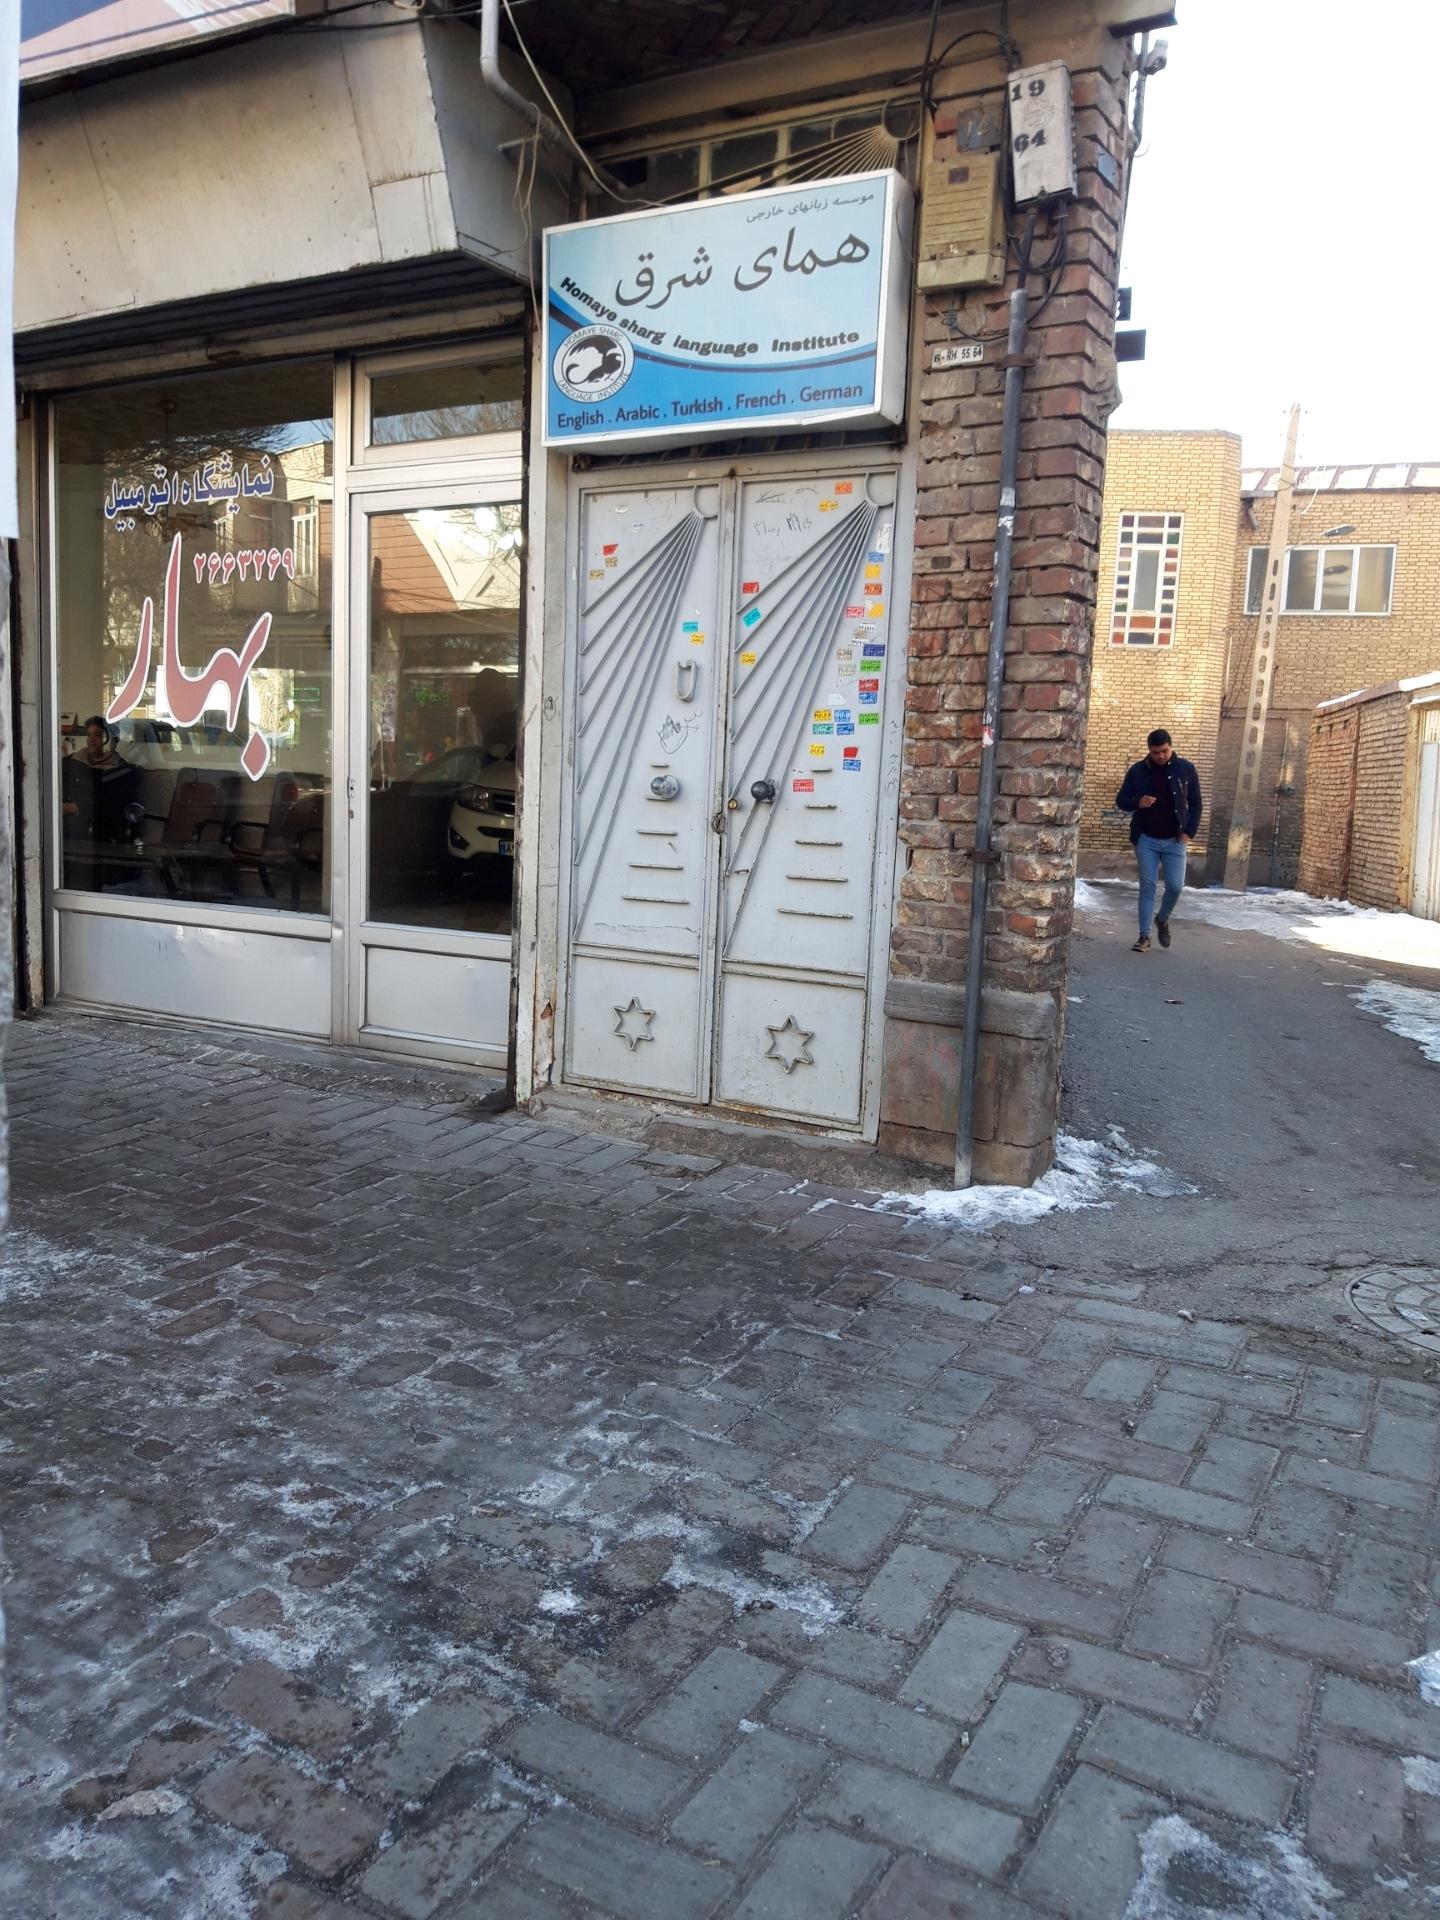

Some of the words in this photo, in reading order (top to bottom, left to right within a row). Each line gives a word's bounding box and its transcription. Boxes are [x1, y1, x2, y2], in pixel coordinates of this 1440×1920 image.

[1011, 79, 1045, 102] 19
[746, 205, 784, 223] خارجی
[788, 197, 829, 216] زبانهای
[833, 193, 875, 206] موسسه
[615, 246, 713, 309] شرق
[733, 226, 870, 291] همای
[560, 277, 618, 322] Homaye
[619, 318, 667, 345] sharg
[673, 335, 759, 358] language
[771, 331, 860, 352] Institute
[563, 327, 597, 348] HOMAYE
[599, 326, 624, 342] SHARG
[557, 410, 604, 431] English
[616, 404, 660, 423] Arabic
[671, 396, 723, 417] Turkish
[735, 388, 786, 410] French
[800, 384, 863, 402] German
[558, 379, 593, 401] LANGUAGE
[597, 373, 629, 400] INSTITUTE
[104, 465, 180, 532] اتومبیل
[181, 451, 275, 516] نمایشگاه
[193, 547, 295, 584] ۲۶۶۳۲۶۹
[105, 531, 273, 783] بهار
